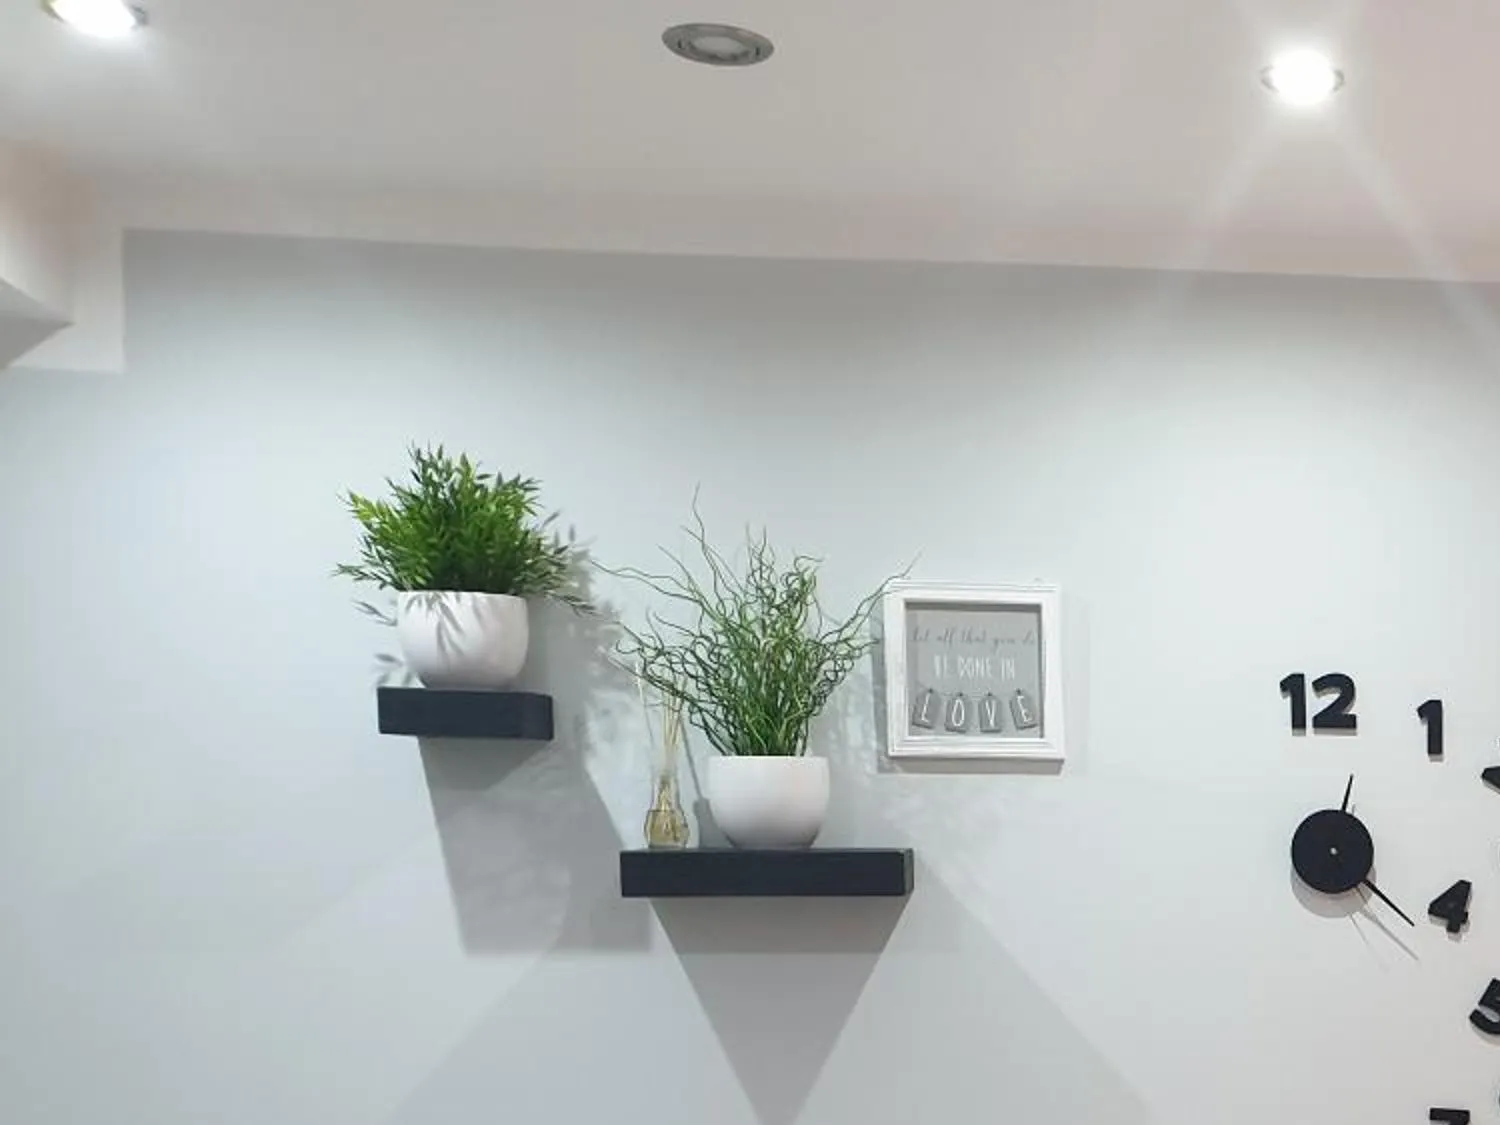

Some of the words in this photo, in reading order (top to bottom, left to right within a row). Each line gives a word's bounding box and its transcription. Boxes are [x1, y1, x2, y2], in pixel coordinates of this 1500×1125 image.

[919, 693, 1035, 728] LOVE
[1279, 673, 1357, 730] 12
[1417, 699, 1443, 755] 1
[1427, 879, 1472, 934] 4
